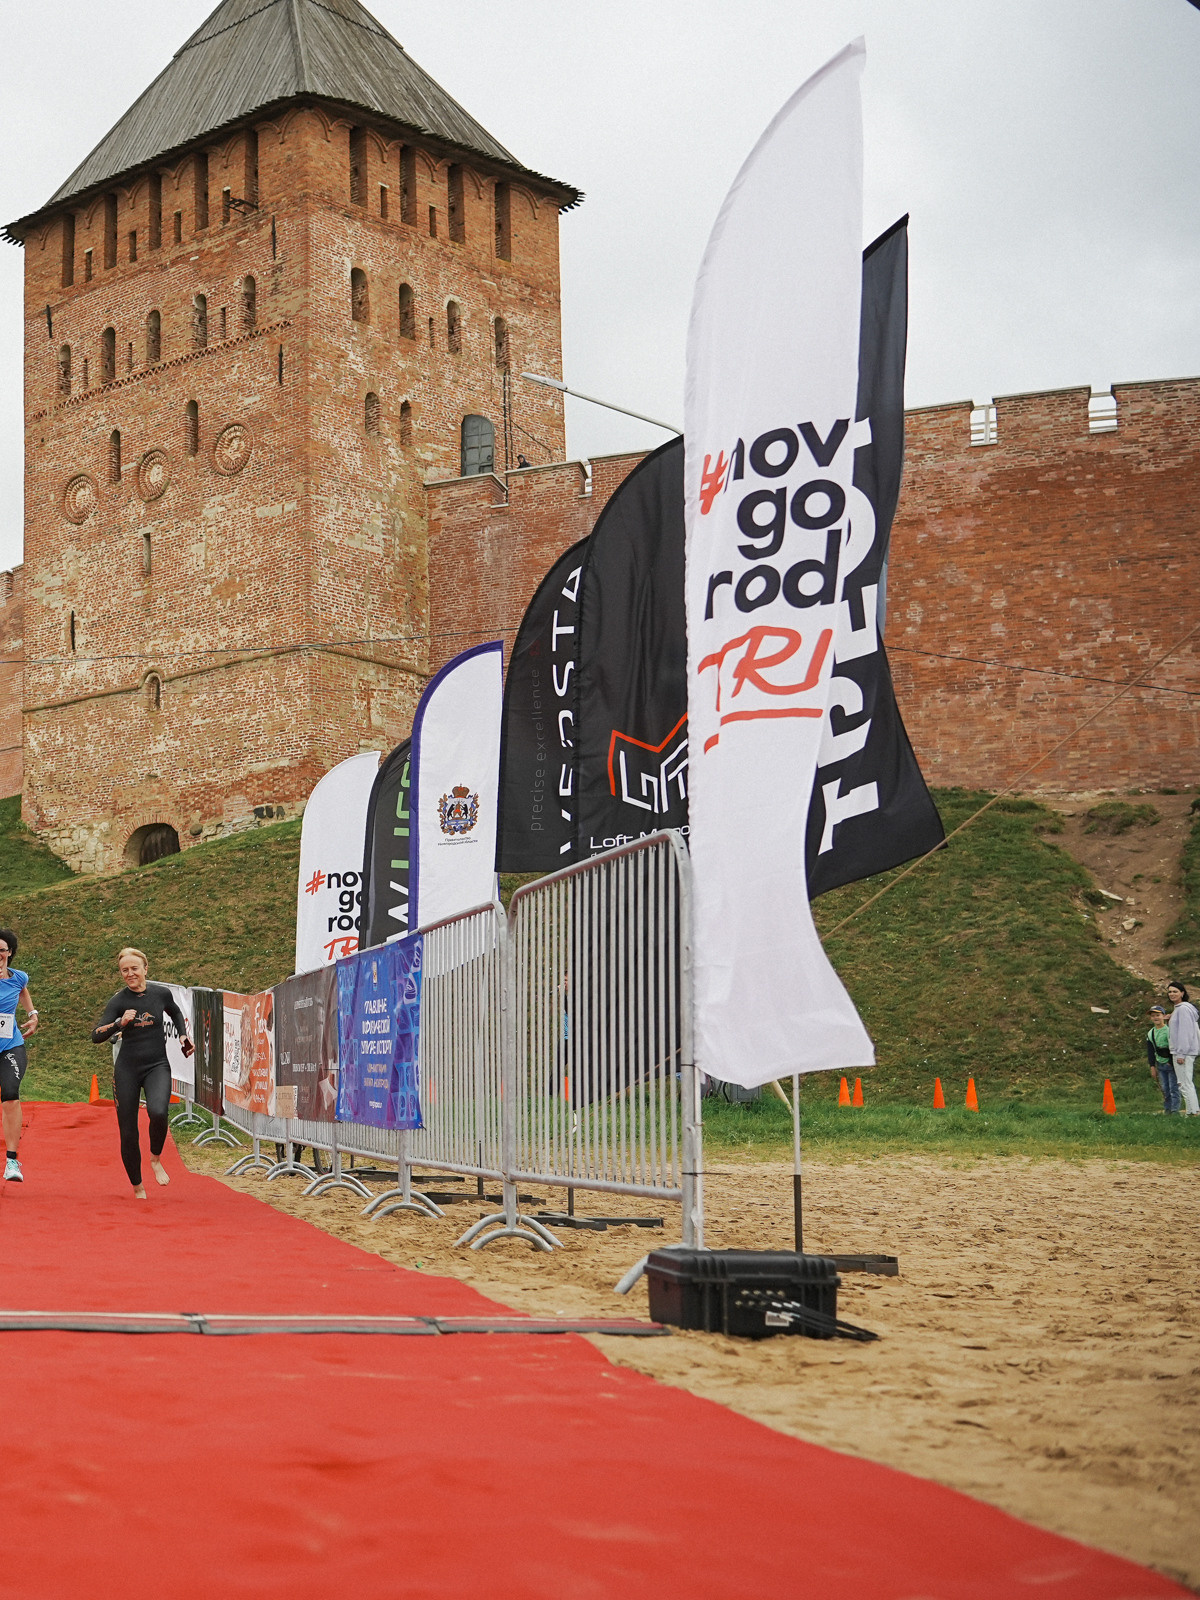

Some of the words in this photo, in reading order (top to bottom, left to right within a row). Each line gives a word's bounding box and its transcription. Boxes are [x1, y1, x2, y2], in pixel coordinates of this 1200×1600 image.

[737, 479, 846, 560] go
[704, 529, 842, 621] rod
[698, 626, 833, 712] TRI
[531, 668, 547, 762] excellence
[529, 769, 545, 832] precise
[590, 834, 633, 849] Loft
